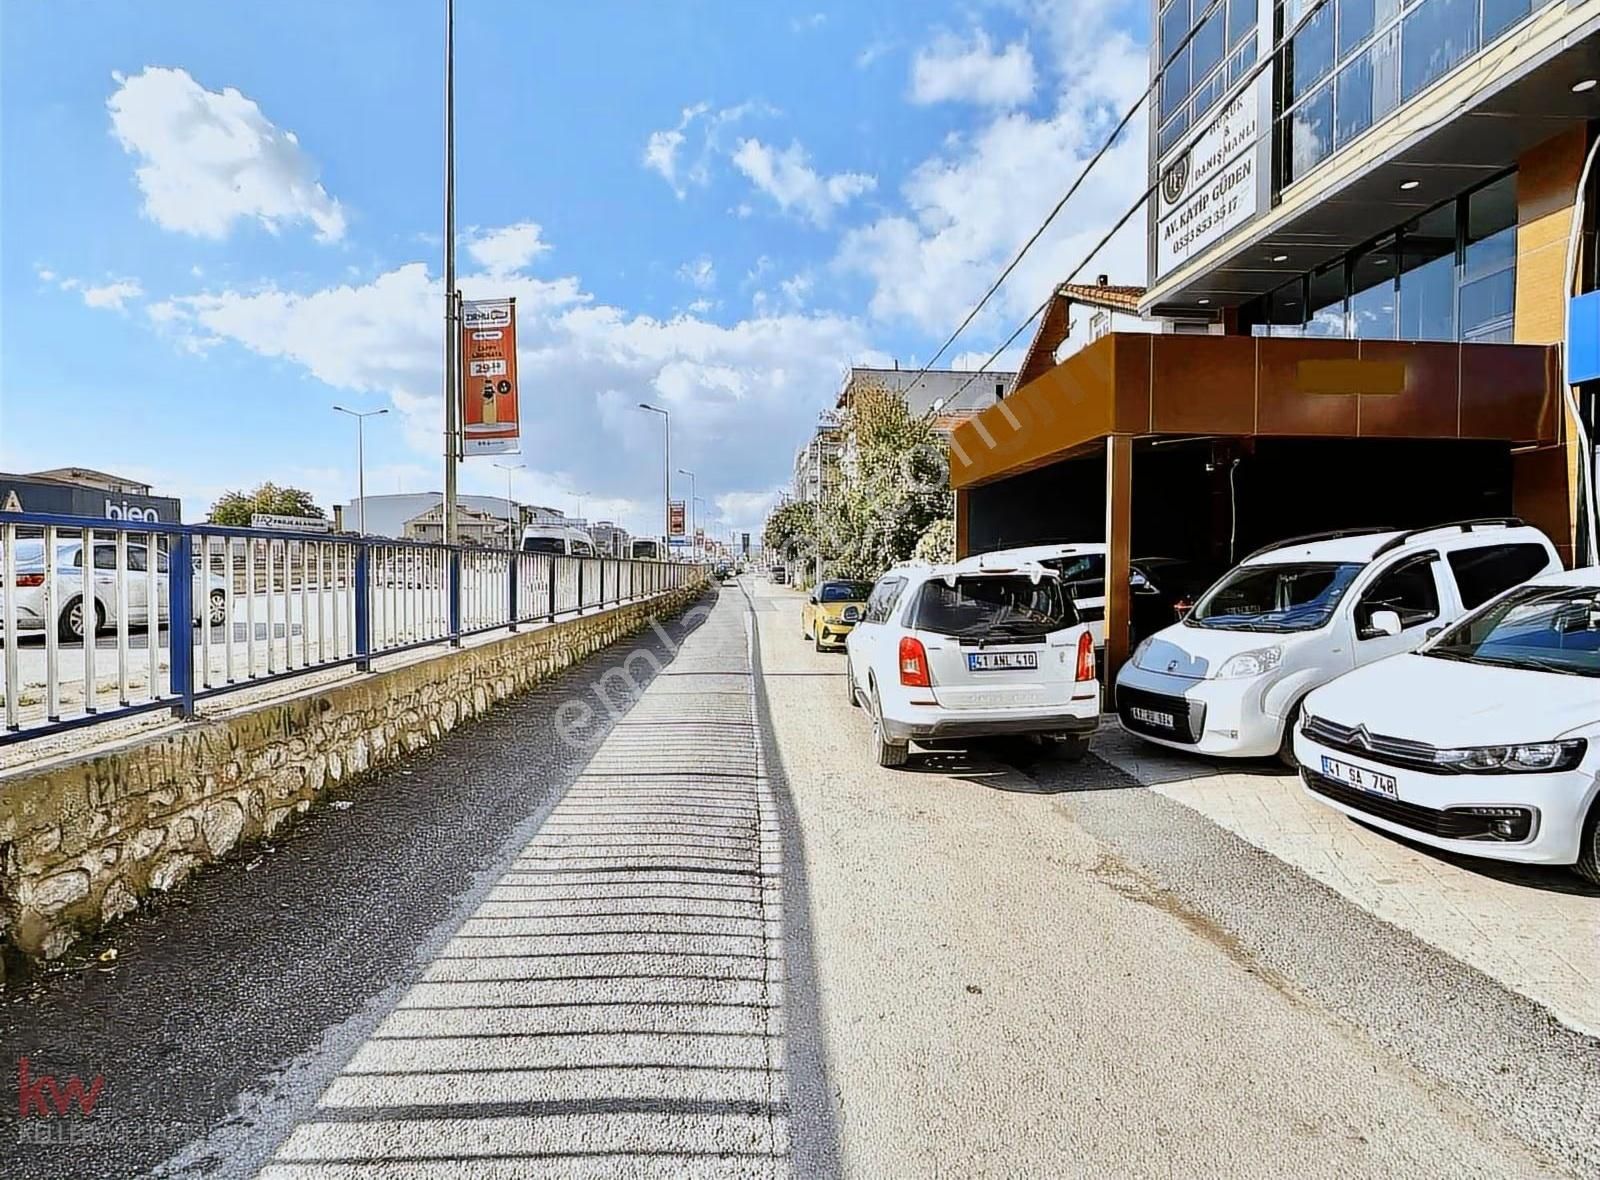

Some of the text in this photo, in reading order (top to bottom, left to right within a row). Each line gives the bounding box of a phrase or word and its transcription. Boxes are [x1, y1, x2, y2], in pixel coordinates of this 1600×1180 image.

[1164, 158, 1252, 241] AV. KATİP GÜDEN
[976, 655, 988, 667] 41
[1329, 761, 1394, 794] 41 SA 748
